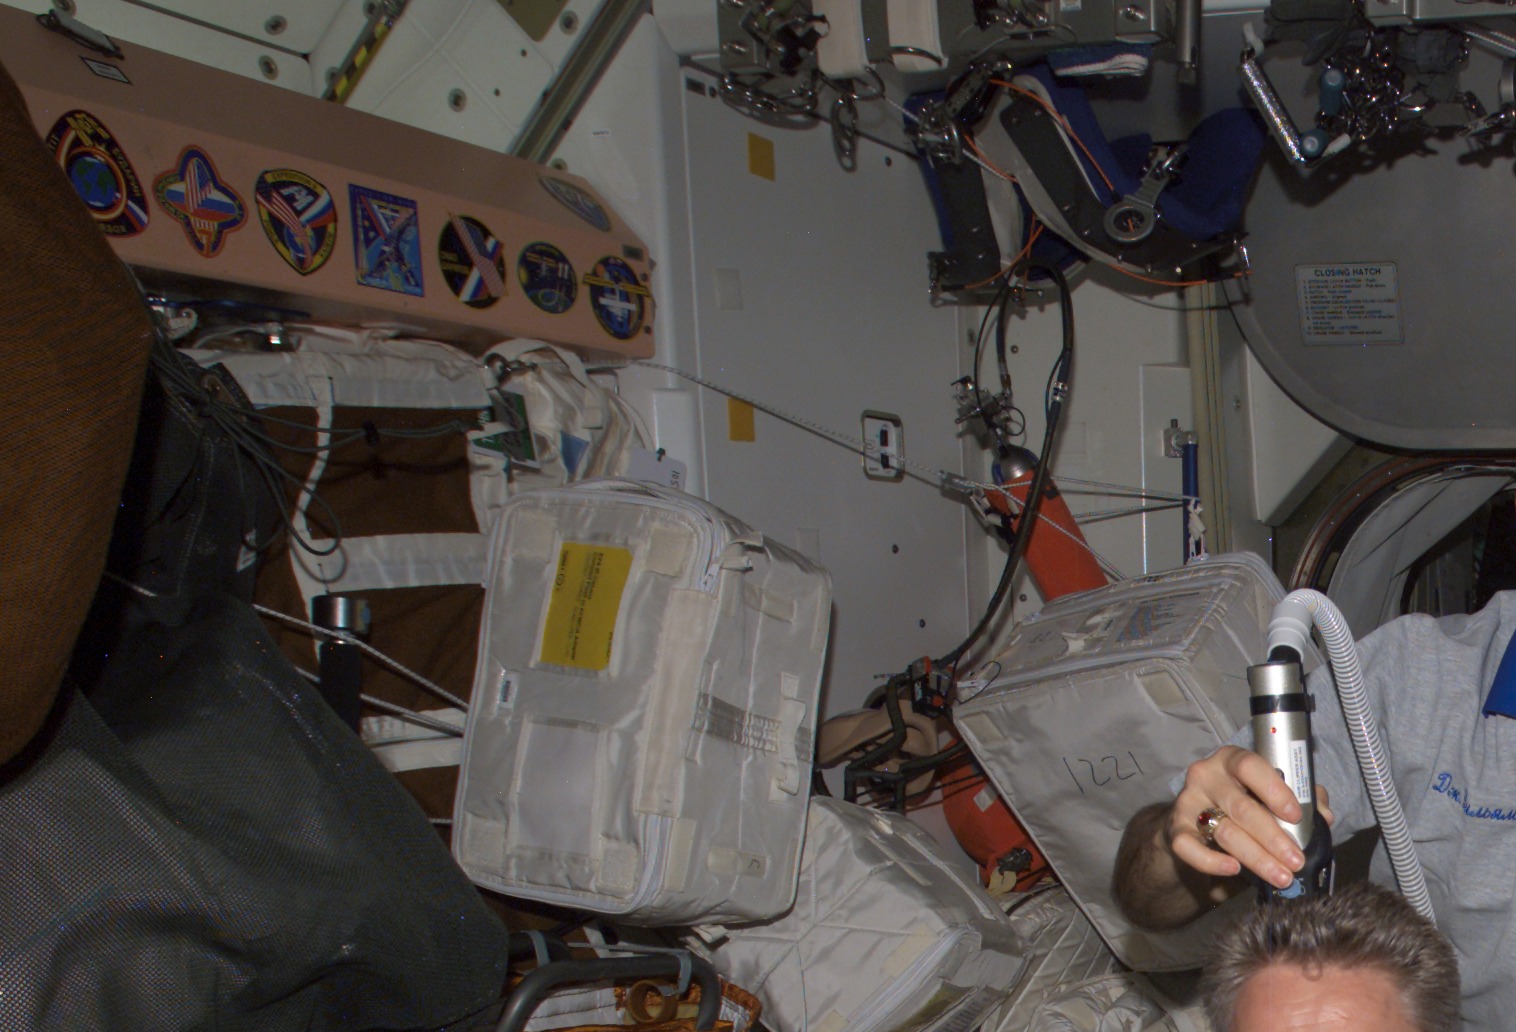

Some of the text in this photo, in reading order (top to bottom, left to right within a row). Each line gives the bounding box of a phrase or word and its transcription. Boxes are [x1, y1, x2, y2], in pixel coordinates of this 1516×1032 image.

[1314, 268, 1381, 277] CLOSING HATCH
[1061, 756, 1145, 795] 1221
